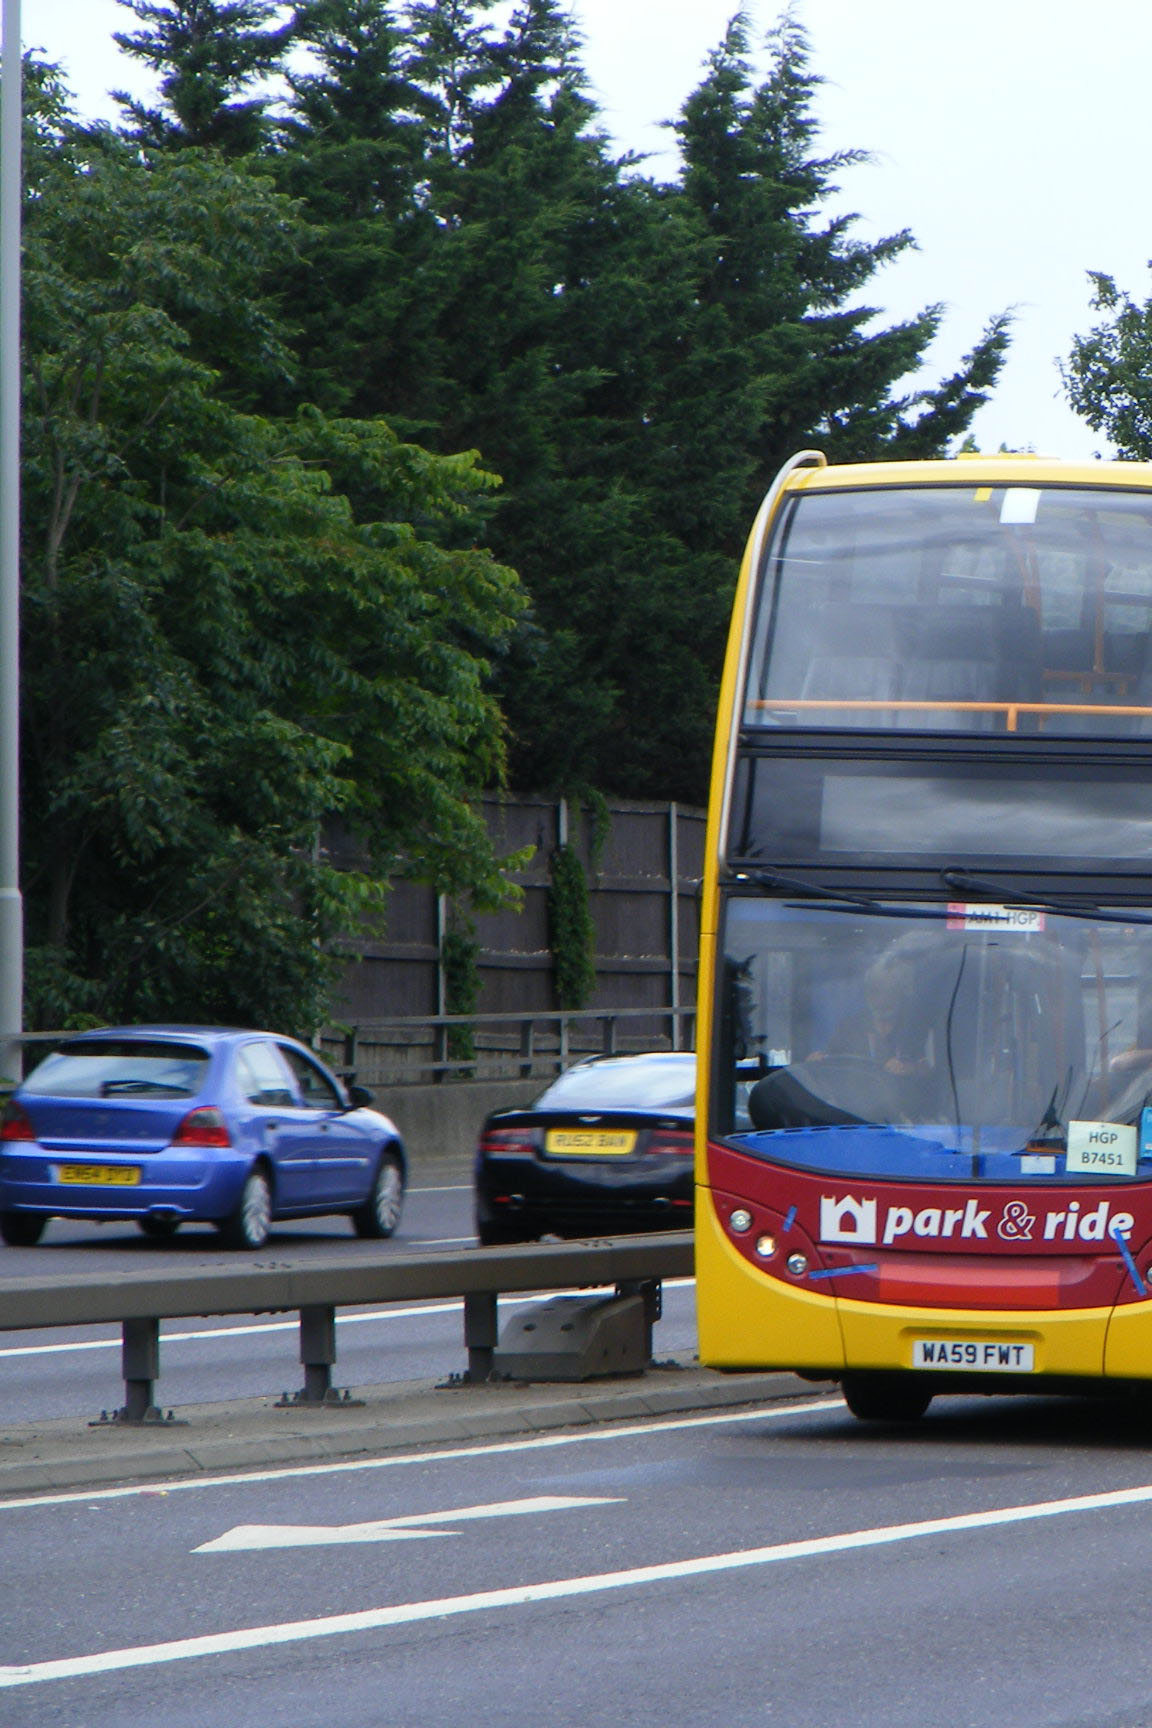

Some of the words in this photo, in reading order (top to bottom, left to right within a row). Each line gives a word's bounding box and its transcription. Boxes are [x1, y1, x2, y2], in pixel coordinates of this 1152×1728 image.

[1088, 1131, 1119, 1145] HGP
[1081, 1151, 1124, 1166] B7451
[882, 1199, 992, 1245] park
[997, 1200, 1036, 1241] &
[1042, 1200, 1135, 1241] ride
[922, 1343, 977, 1364] WA59
[983, 1344, 1025, 1366] FWT
